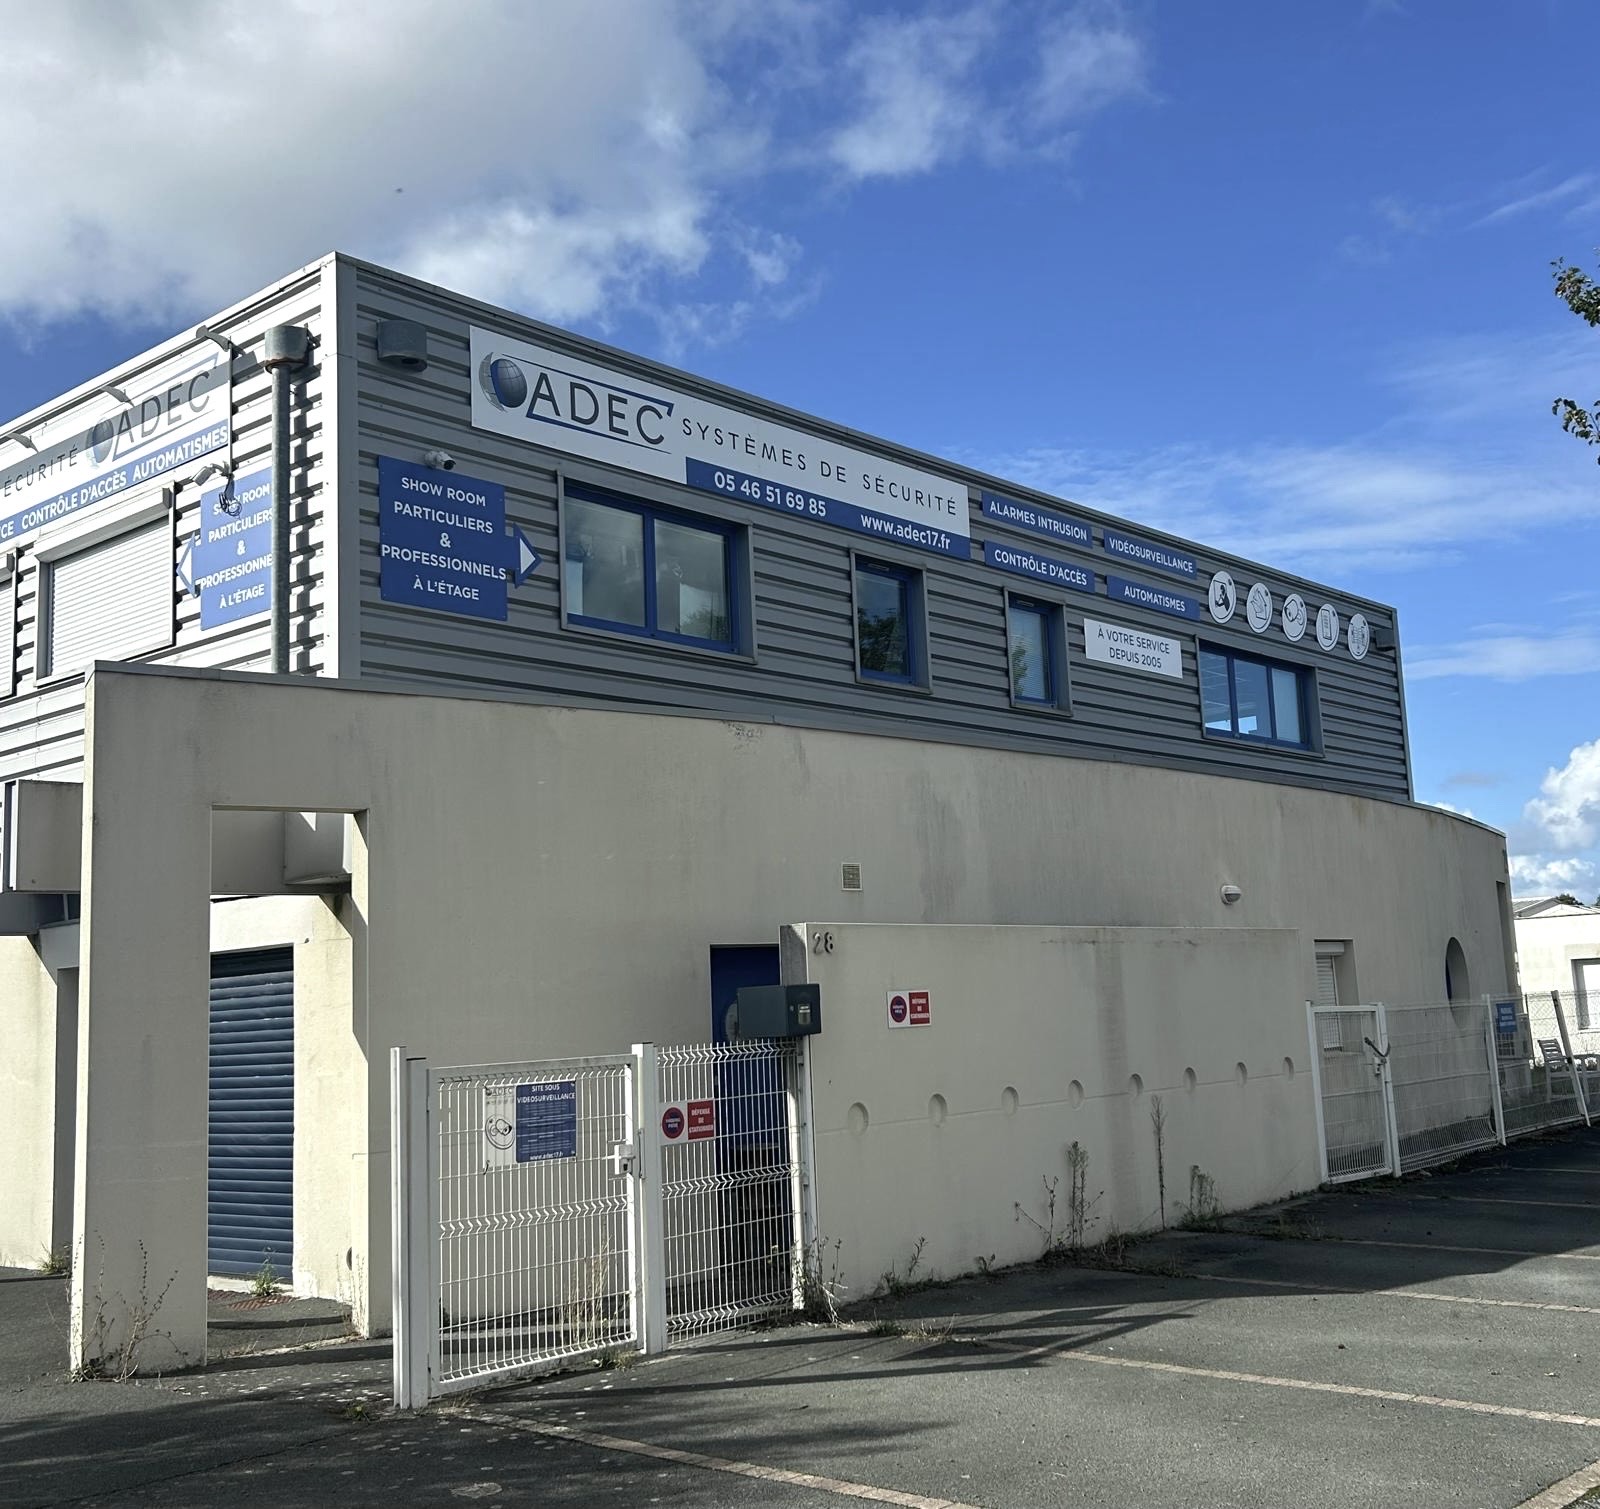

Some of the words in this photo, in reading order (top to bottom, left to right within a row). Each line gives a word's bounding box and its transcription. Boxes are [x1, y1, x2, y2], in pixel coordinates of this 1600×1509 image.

[112, 370, 210, 461] ADEC
[526, 372, 665, 445] ADEC
[21, 492, 78, 530] CONTRÔLE
[80, 471, 127, 504] D'ACCÈS
[133, 425, 228, 482] AUTOMATISMES
[682, 418, 807, 470] SYSTÈMES
[820, 461, 847, 483] DE
[862, 473, 956, 515] SÉCURITÉ
[242, 483, 270, 504] ROOM
[401, 477, 443, 496] SHOW
[447, 487, 486, 507] ROOM
[714, 471, 735, 492] 05
[740, 478, 761, 499] 46
[766, 485, 781, 504] 51
[785, 491, 804, 510] 69
[808, 498, 826, 517] 85
[394, 501, 493, 534] PARTICULIERS
[860, 514, 950, 550] www.adec17.fr
[990, 501, 1036, 525] ALARMES
[1038, 516, 1087, 541] INTRUSION
[236, 540, 246, 556] &
[440, 533, 451, 548] &
[1109, 537, 1194, 573] VIDÉOSURVEILLANCE
[200, 554, 273, 590] PROFESSIONNE
[381, 544, 507, 580] PROFESSIONNELS
[994, 549, 1047, 575] CONTRÔLE
[1049, 565, 1087, 585] D'ACCÈS
[219, 594, 227, 609] À
[413, 575, 423, 591] À
[427, 579, 480, 601] L'ÉTAGE
[1124, 585, 1186, 612] AUTOMATISMES
[1097, 625, 1105, 639] À
[1106, 629, 1134, 646] VOTRE
[1136, 636, 1170, 654] SERVICE
[1109, 647, 1140, 664] DEPUIS
[1141, 654, 1162, 668] 2005
[813, 931, 834, 954] 28
